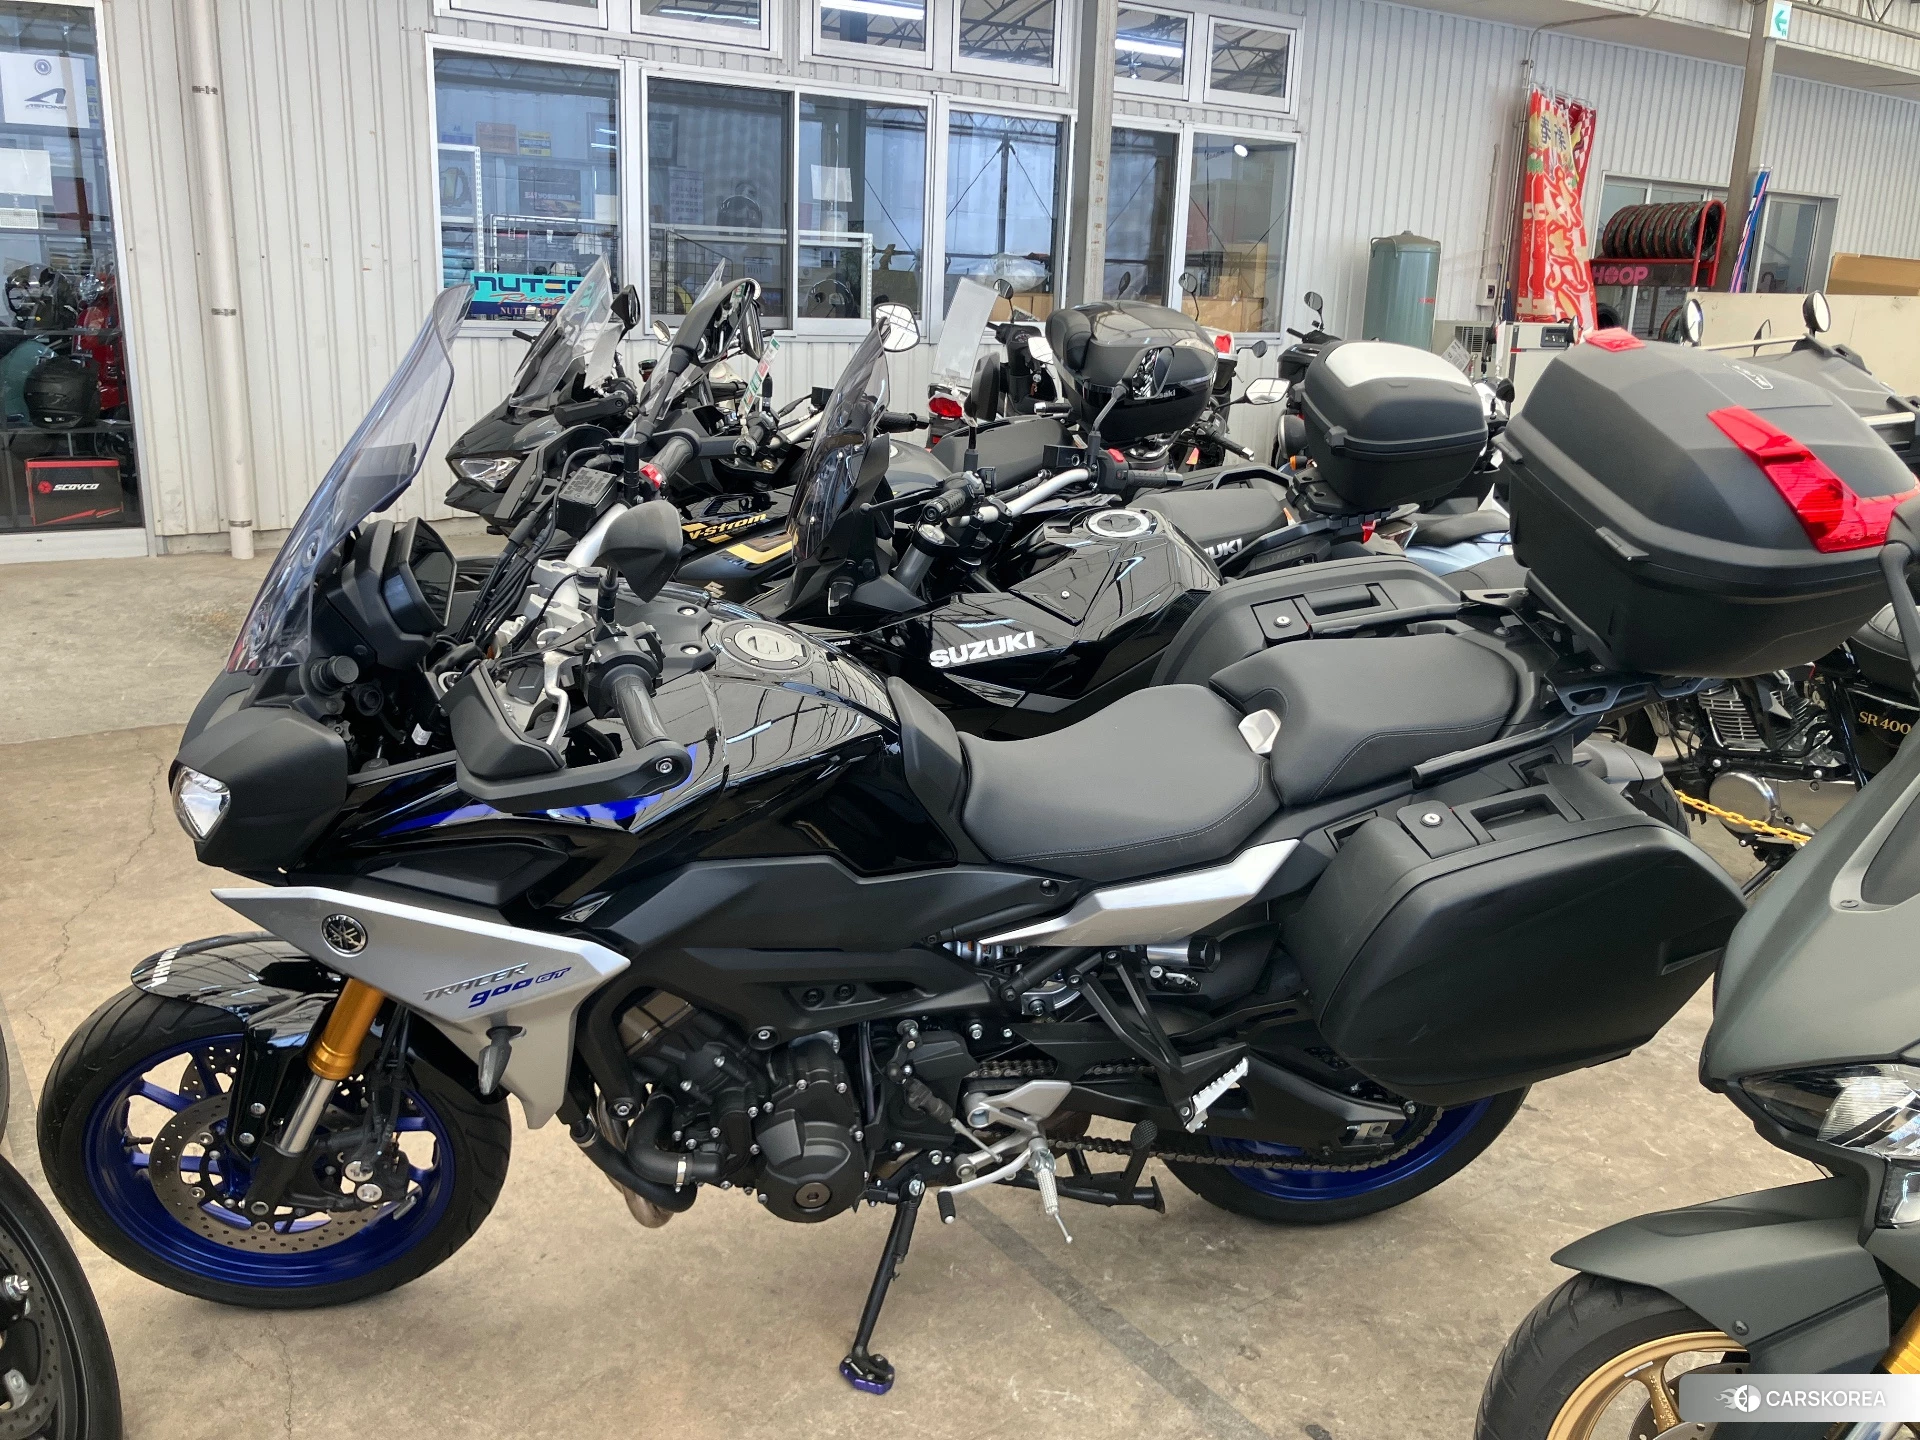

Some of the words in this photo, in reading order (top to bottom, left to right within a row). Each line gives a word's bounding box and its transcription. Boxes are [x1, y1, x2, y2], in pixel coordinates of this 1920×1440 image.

[53, 483, 100, 491] SCOYCO
[1204, 538, 1243, 560] UKI
[929, 630, 1036, 669] SUZUKI
[1858, 711, 1878, 727] SR
[1880, 718, 1911, 735] 400
[422, 962, 529, 1001] TRACER
[468, 977, 534, 1008] 900
[535, 966, 572, 984] GT
